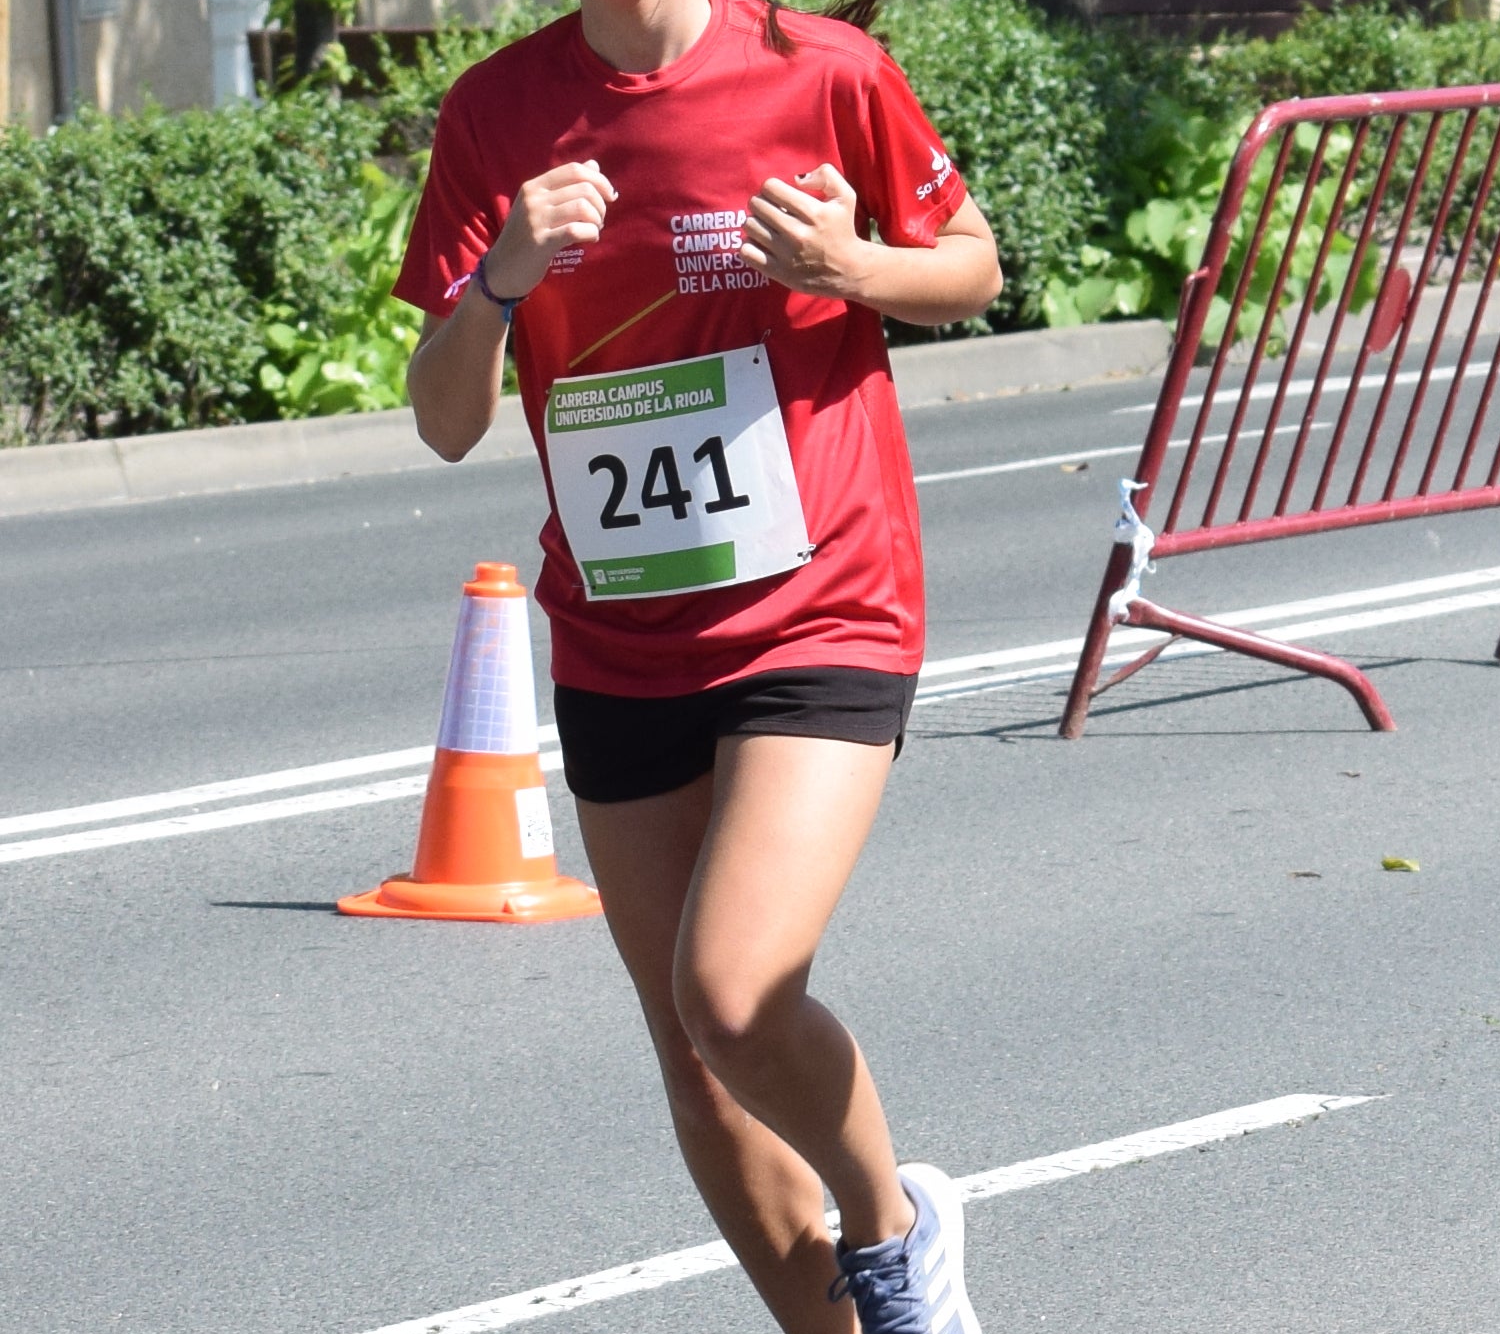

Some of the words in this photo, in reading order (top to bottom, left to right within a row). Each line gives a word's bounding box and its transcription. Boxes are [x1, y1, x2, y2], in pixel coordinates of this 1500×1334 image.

[670, 210, 747, 234] CARRERA
[672, 231, 743, 254] CAMPUS
[679, 276, 699, 294] DE
[701, 274, 724, 292] LA
[725, 271, 770, 290] RIOJA
[555, 388, 607, 409] CARRERA
[608, 380, 665, 403] CAMPUS
[555, 402, 634, 427] UNIVERSIDAD
[634, 400, 654, 416] DE
[654, 396, 674, 412] LA
[674, 388, 715, 409] RIOJA
[588, 435, 750, 530] 241
